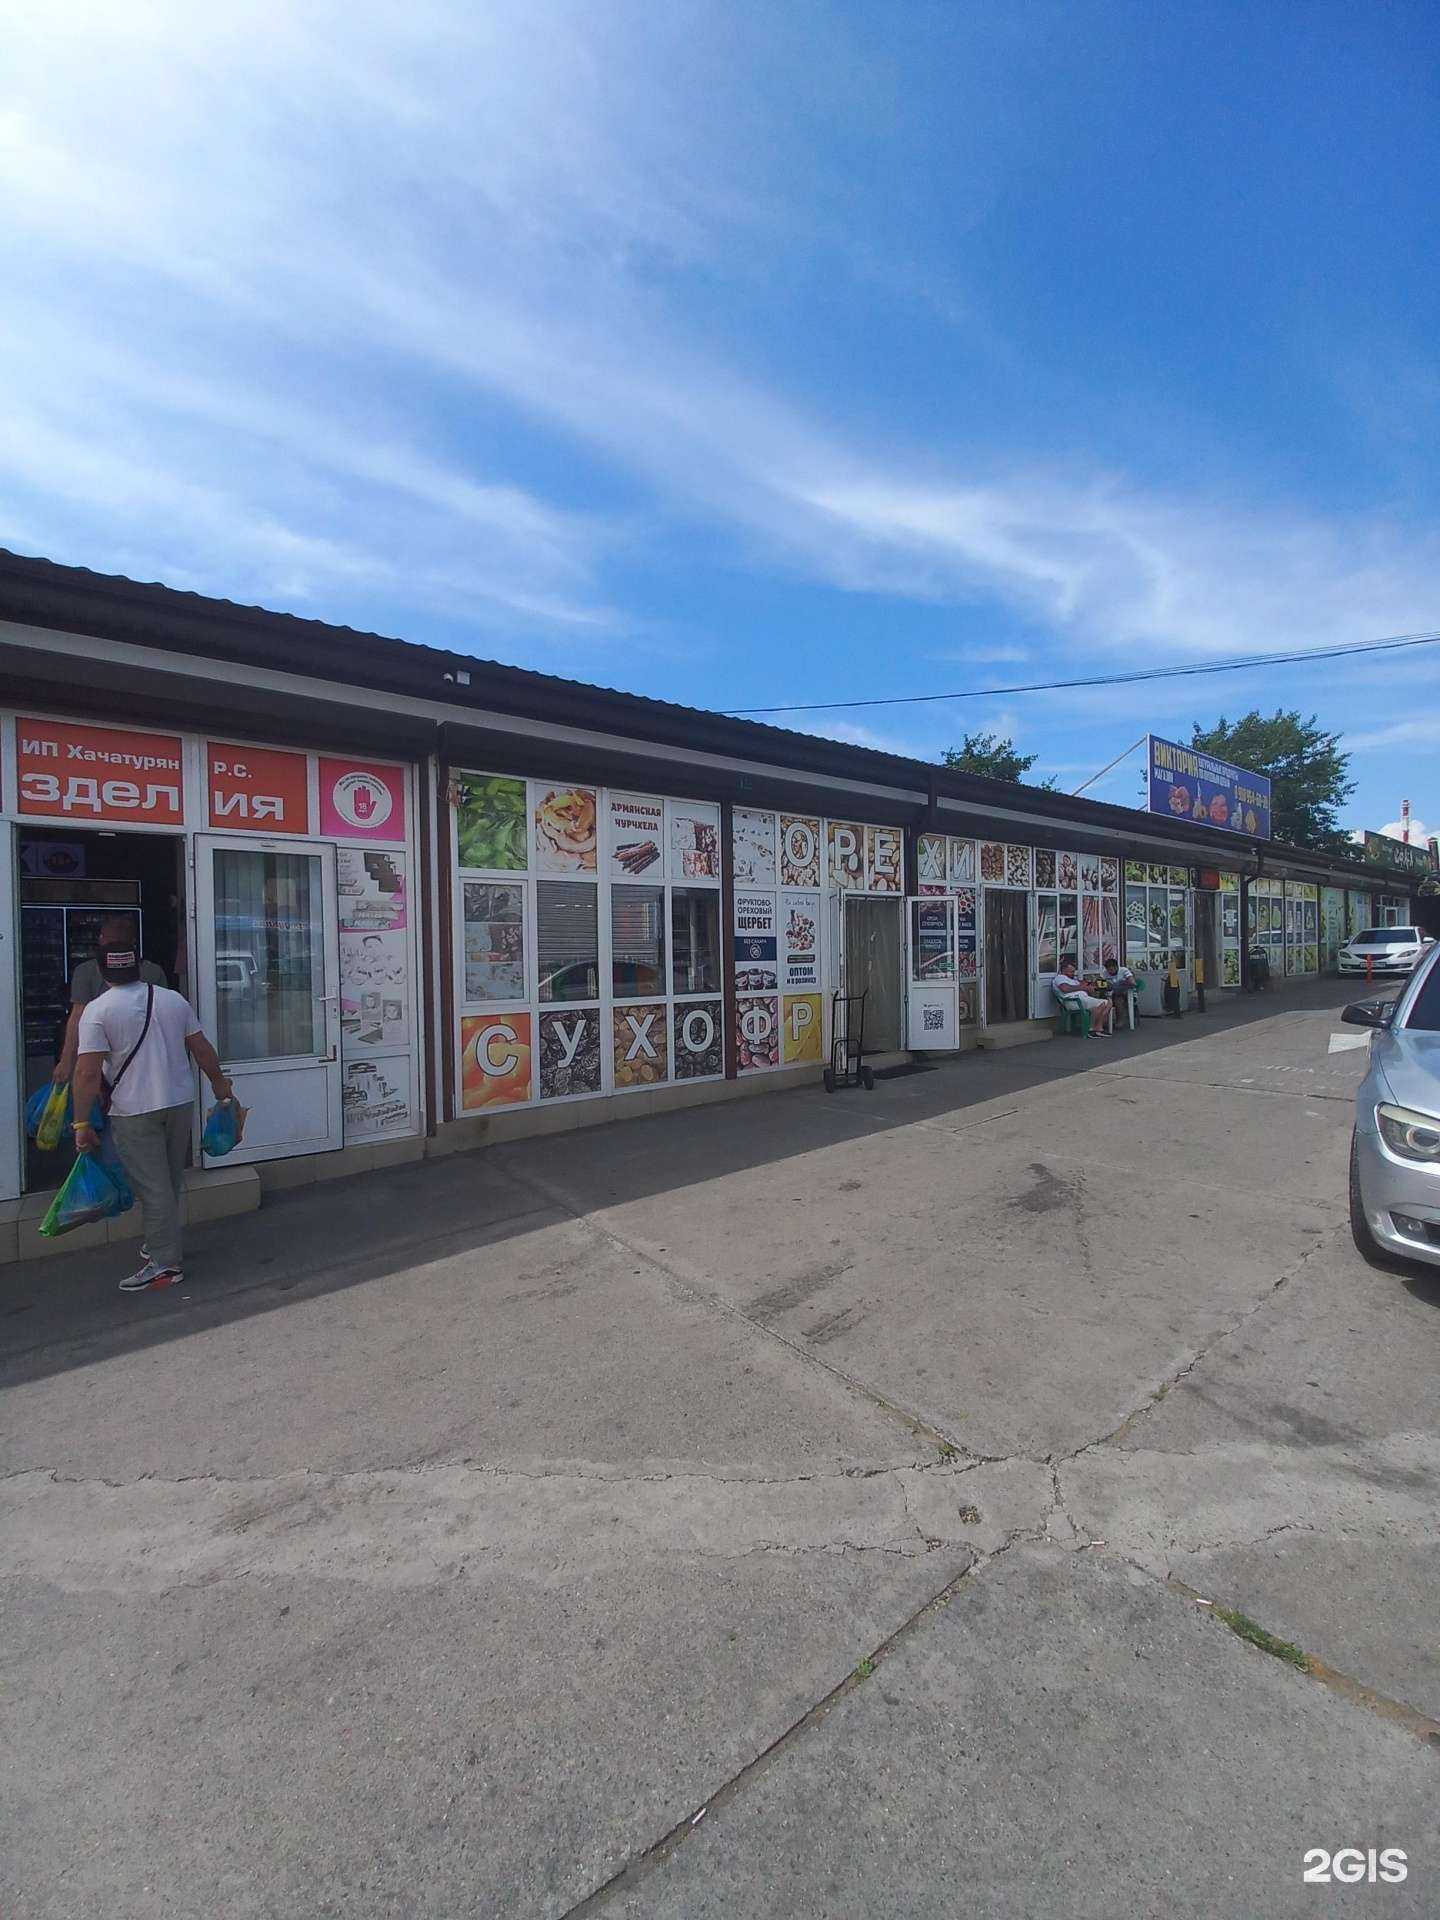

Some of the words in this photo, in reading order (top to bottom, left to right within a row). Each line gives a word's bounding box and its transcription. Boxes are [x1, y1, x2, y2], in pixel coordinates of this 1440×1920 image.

[22, 739, 58, 758] ИП
[67, 745, 180, 771] Хачатурян
[214, 761, 253, 778] Р.С.
[1154, 741, 1199, 778] ВИКТОРИЯ
[611, 802, 662, 817] АРМЯНСКАЯ
[614, 818, 659, 832] ЧУРЧХЕЛА
[737, 898, 772, 907] ФРУКТОВО-
[737, 906, 773, 915] ОРЕХОВЫЙ
[738, 916, 773, 931] ЩЕРБЕТ
[789, 966, 814, 977] ОПТОМ
